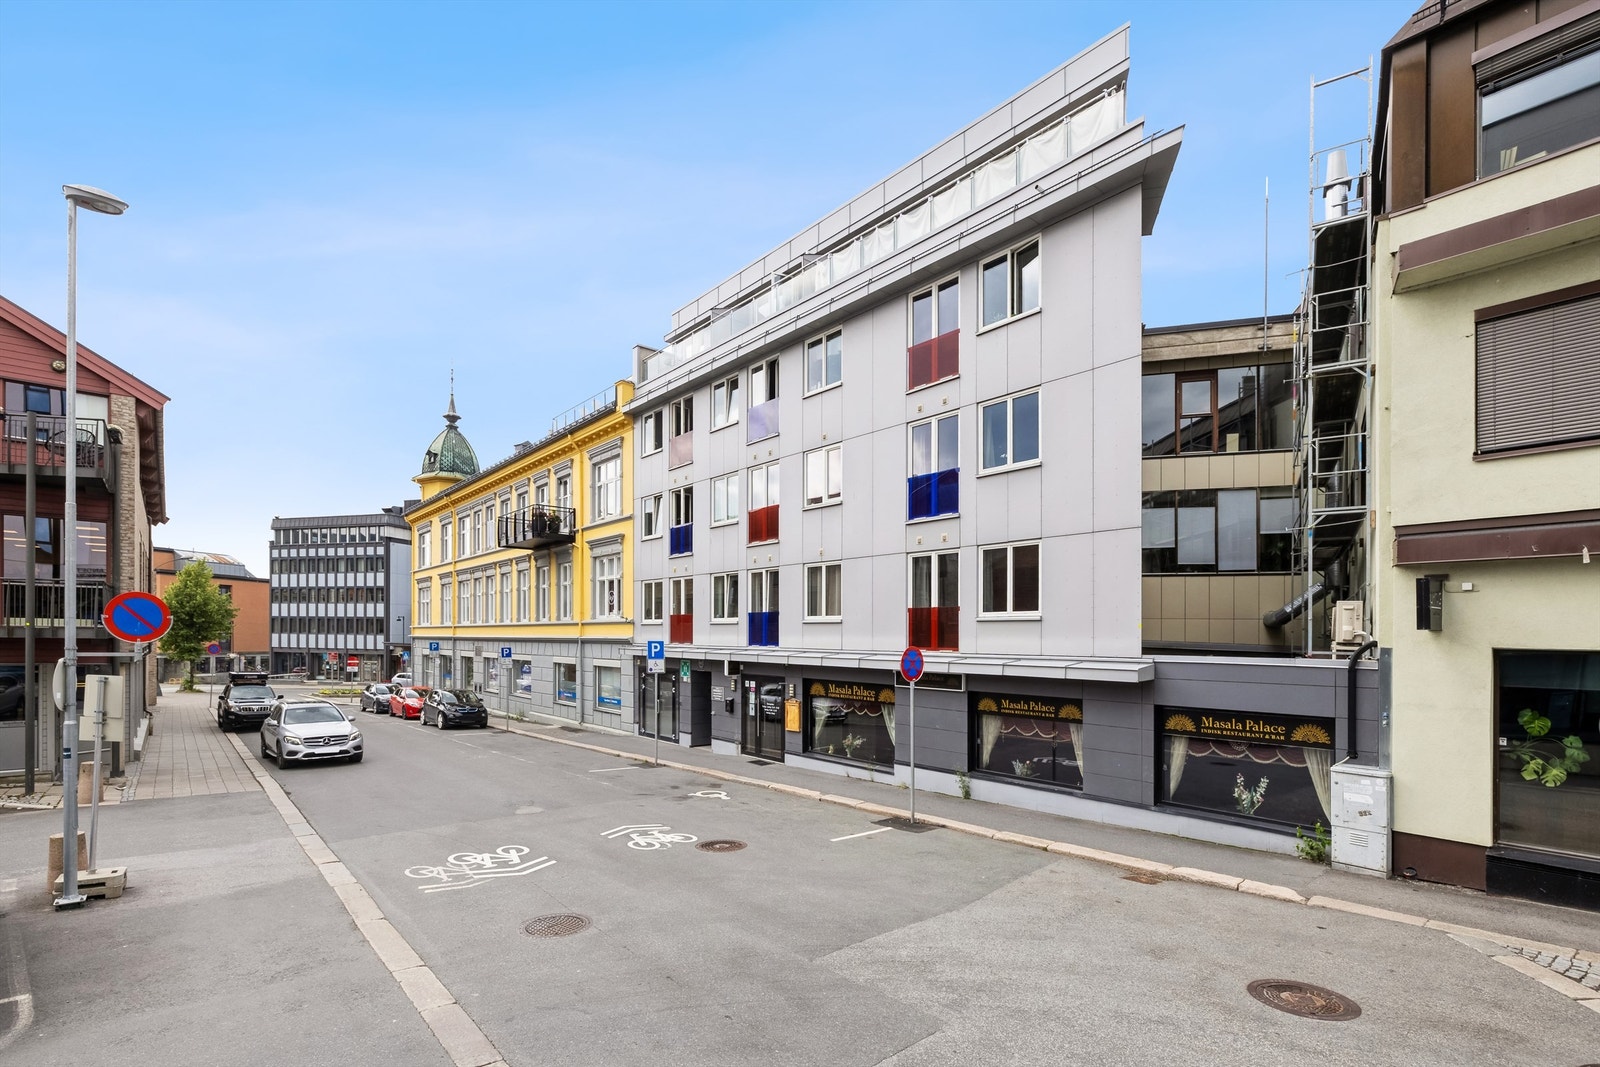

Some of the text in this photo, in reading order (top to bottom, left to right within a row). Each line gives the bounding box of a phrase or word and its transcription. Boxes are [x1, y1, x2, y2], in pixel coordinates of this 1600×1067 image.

[503, 648, 510, 656] P
[651, 643, 660, 657] P
[828, 684, 876, 696] Masala Palace
[1001, 699, 1055, 712] Masala Palace
[1201, 716, 1286, 733] Masala Palace
